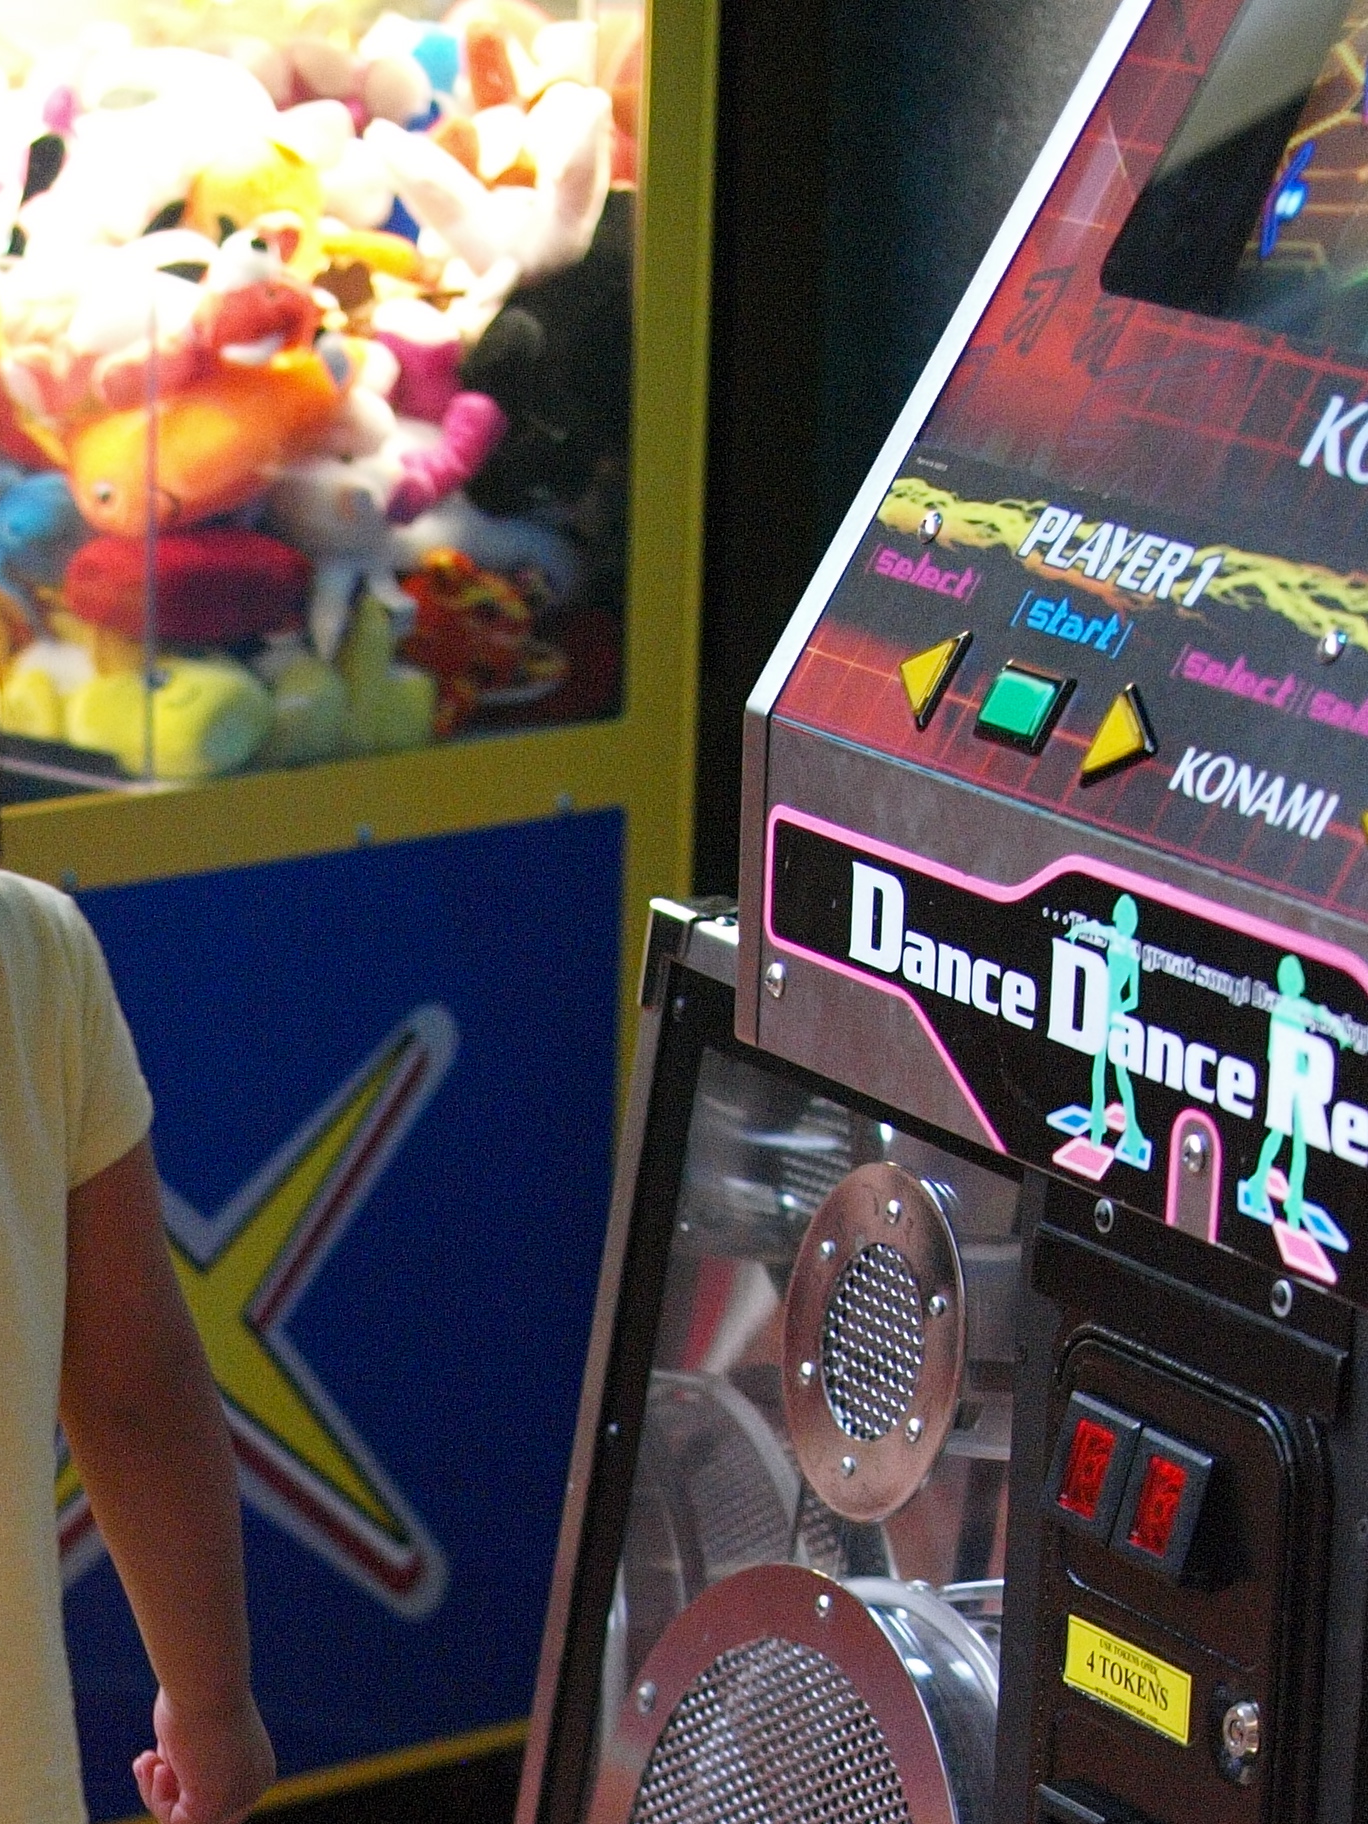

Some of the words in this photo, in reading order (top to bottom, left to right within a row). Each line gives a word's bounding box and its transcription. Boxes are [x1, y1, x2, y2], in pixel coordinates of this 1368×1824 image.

[875, 547, 974, 599] select
[1018, 506, 1195, 600] PLAYER
[1182, 555, 1223, 607] 1
[1027, 597, 1119, 651] start
[1183, 651, 1296, 709] select
[1168, 746, 1340, 840] KONAMI
[849, 861, 1036, 1030] Dance
[1047, 938, 1256, 1119] Dance
[1086, 1650, 1095, 1673] 4
[1099, 1655, 1169, 1711] TOKENS
